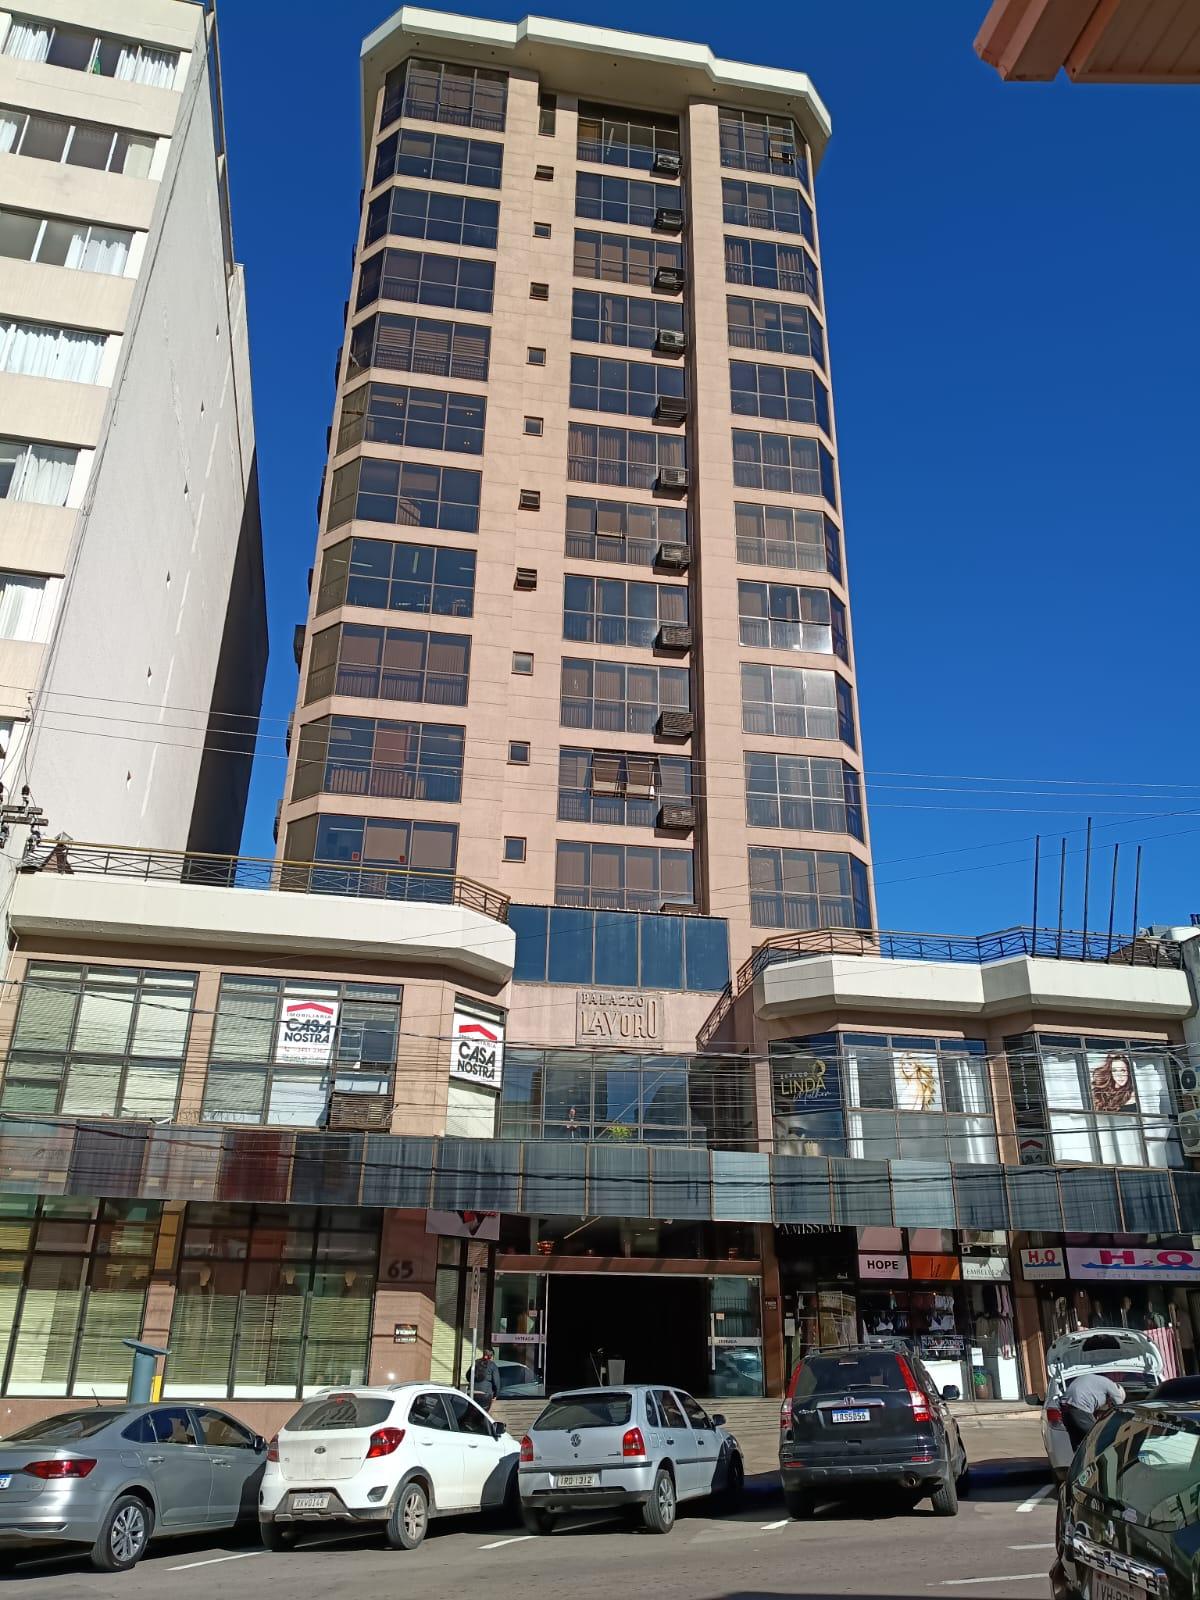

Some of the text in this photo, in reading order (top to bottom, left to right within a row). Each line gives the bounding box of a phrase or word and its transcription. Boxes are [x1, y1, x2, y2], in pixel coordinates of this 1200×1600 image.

[581, 992, 644, 1008] PALAZZO
[286, 1018, 331, 1034] CASA
[581, 1000, 658, 1039] LAVORO
[284, 1031, 330, 1044] NOSTRA
[459, 1041, 496, 1068] CASA
[457, 1058, 495, 1080] NOSTRA
[781, 1077, 827, 1095] LINDA
[388, 1260, 414, 1279] 65
[867, 1260, 899, 1270] HOPE
